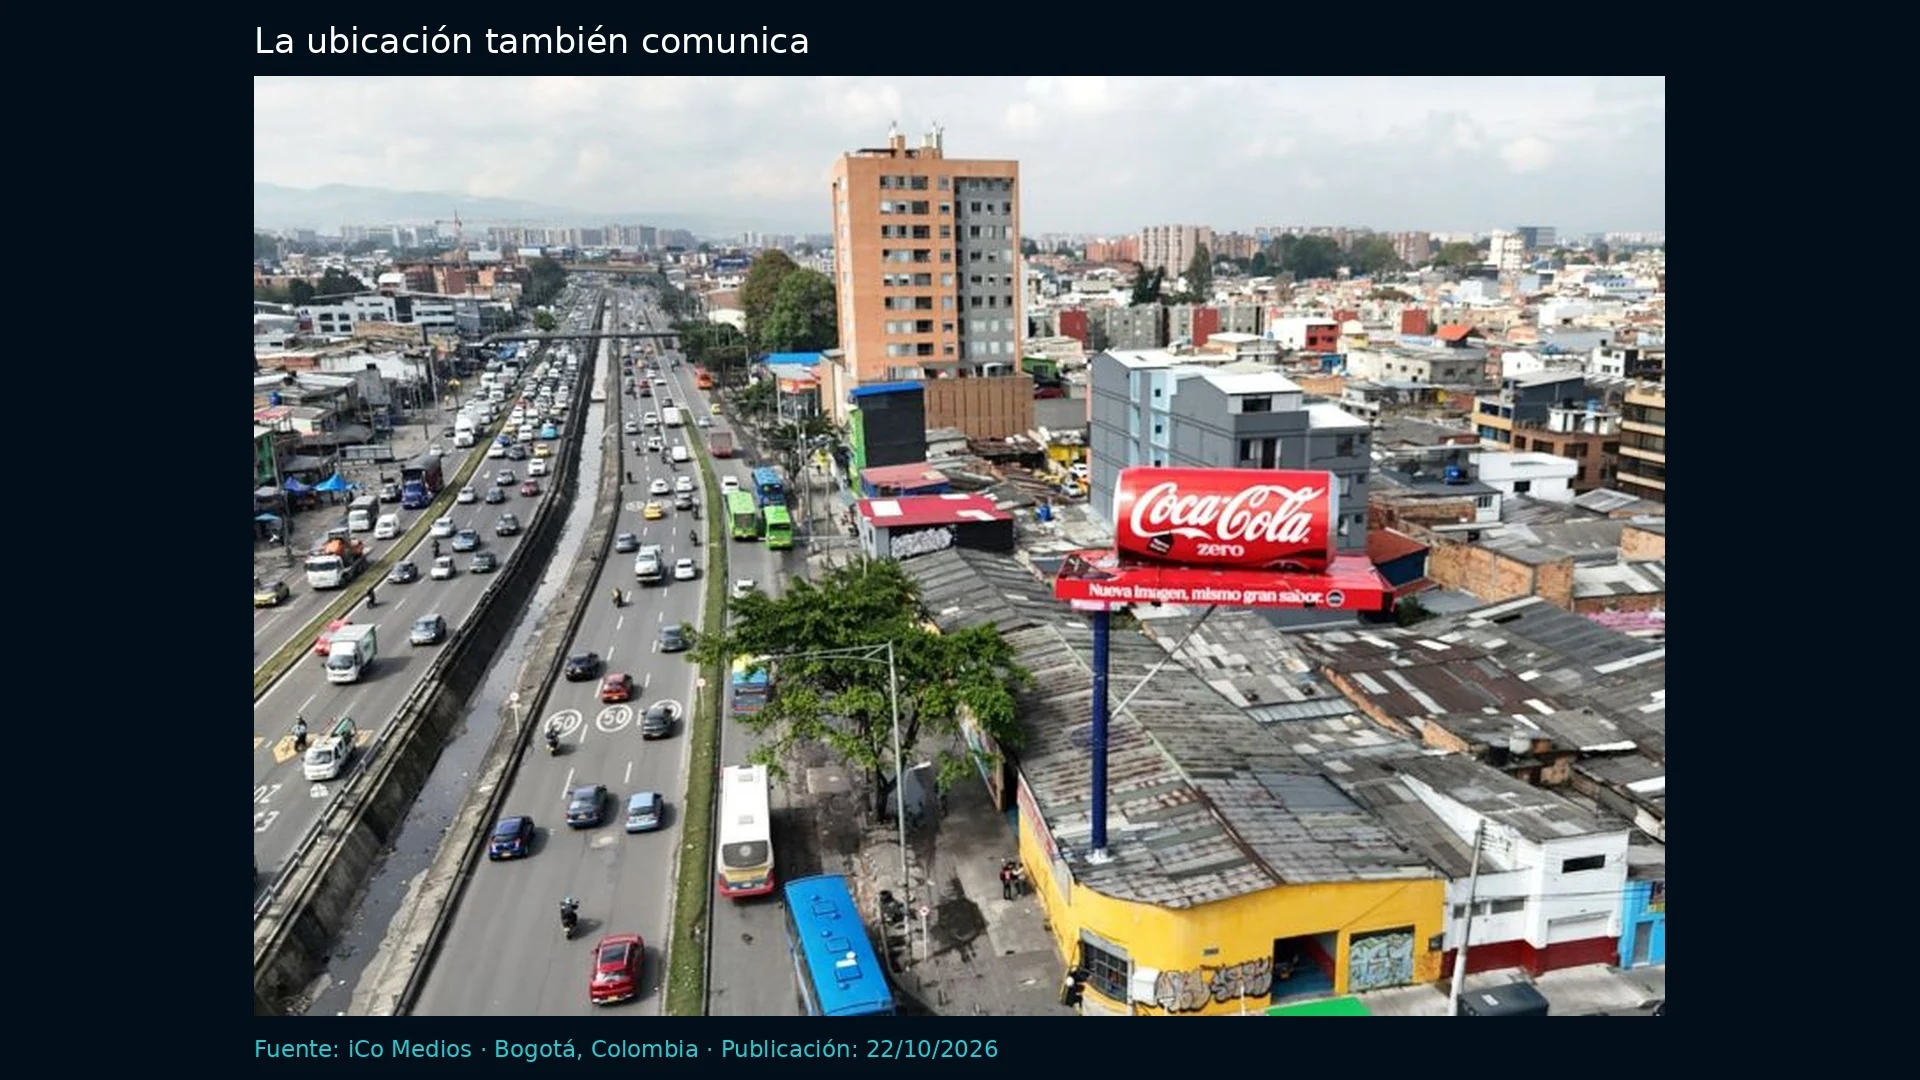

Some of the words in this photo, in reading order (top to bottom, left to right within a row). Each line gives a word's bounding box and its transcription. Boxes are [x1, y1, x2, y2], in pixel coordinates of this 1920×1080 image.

[1130, 481, 1326, 543] Coca-Cola
[1196, 543, 1245, 557] zero
[1089, 583, 1134, 598] Nueva
[1191, 586, 1241, 601] mismo
[1243, 590, 1277, 604] gran
[1279, 589, 1324, 604] sabor.
[552, 715, 576, 730] 50
[604, 709, 627, 725] 50
